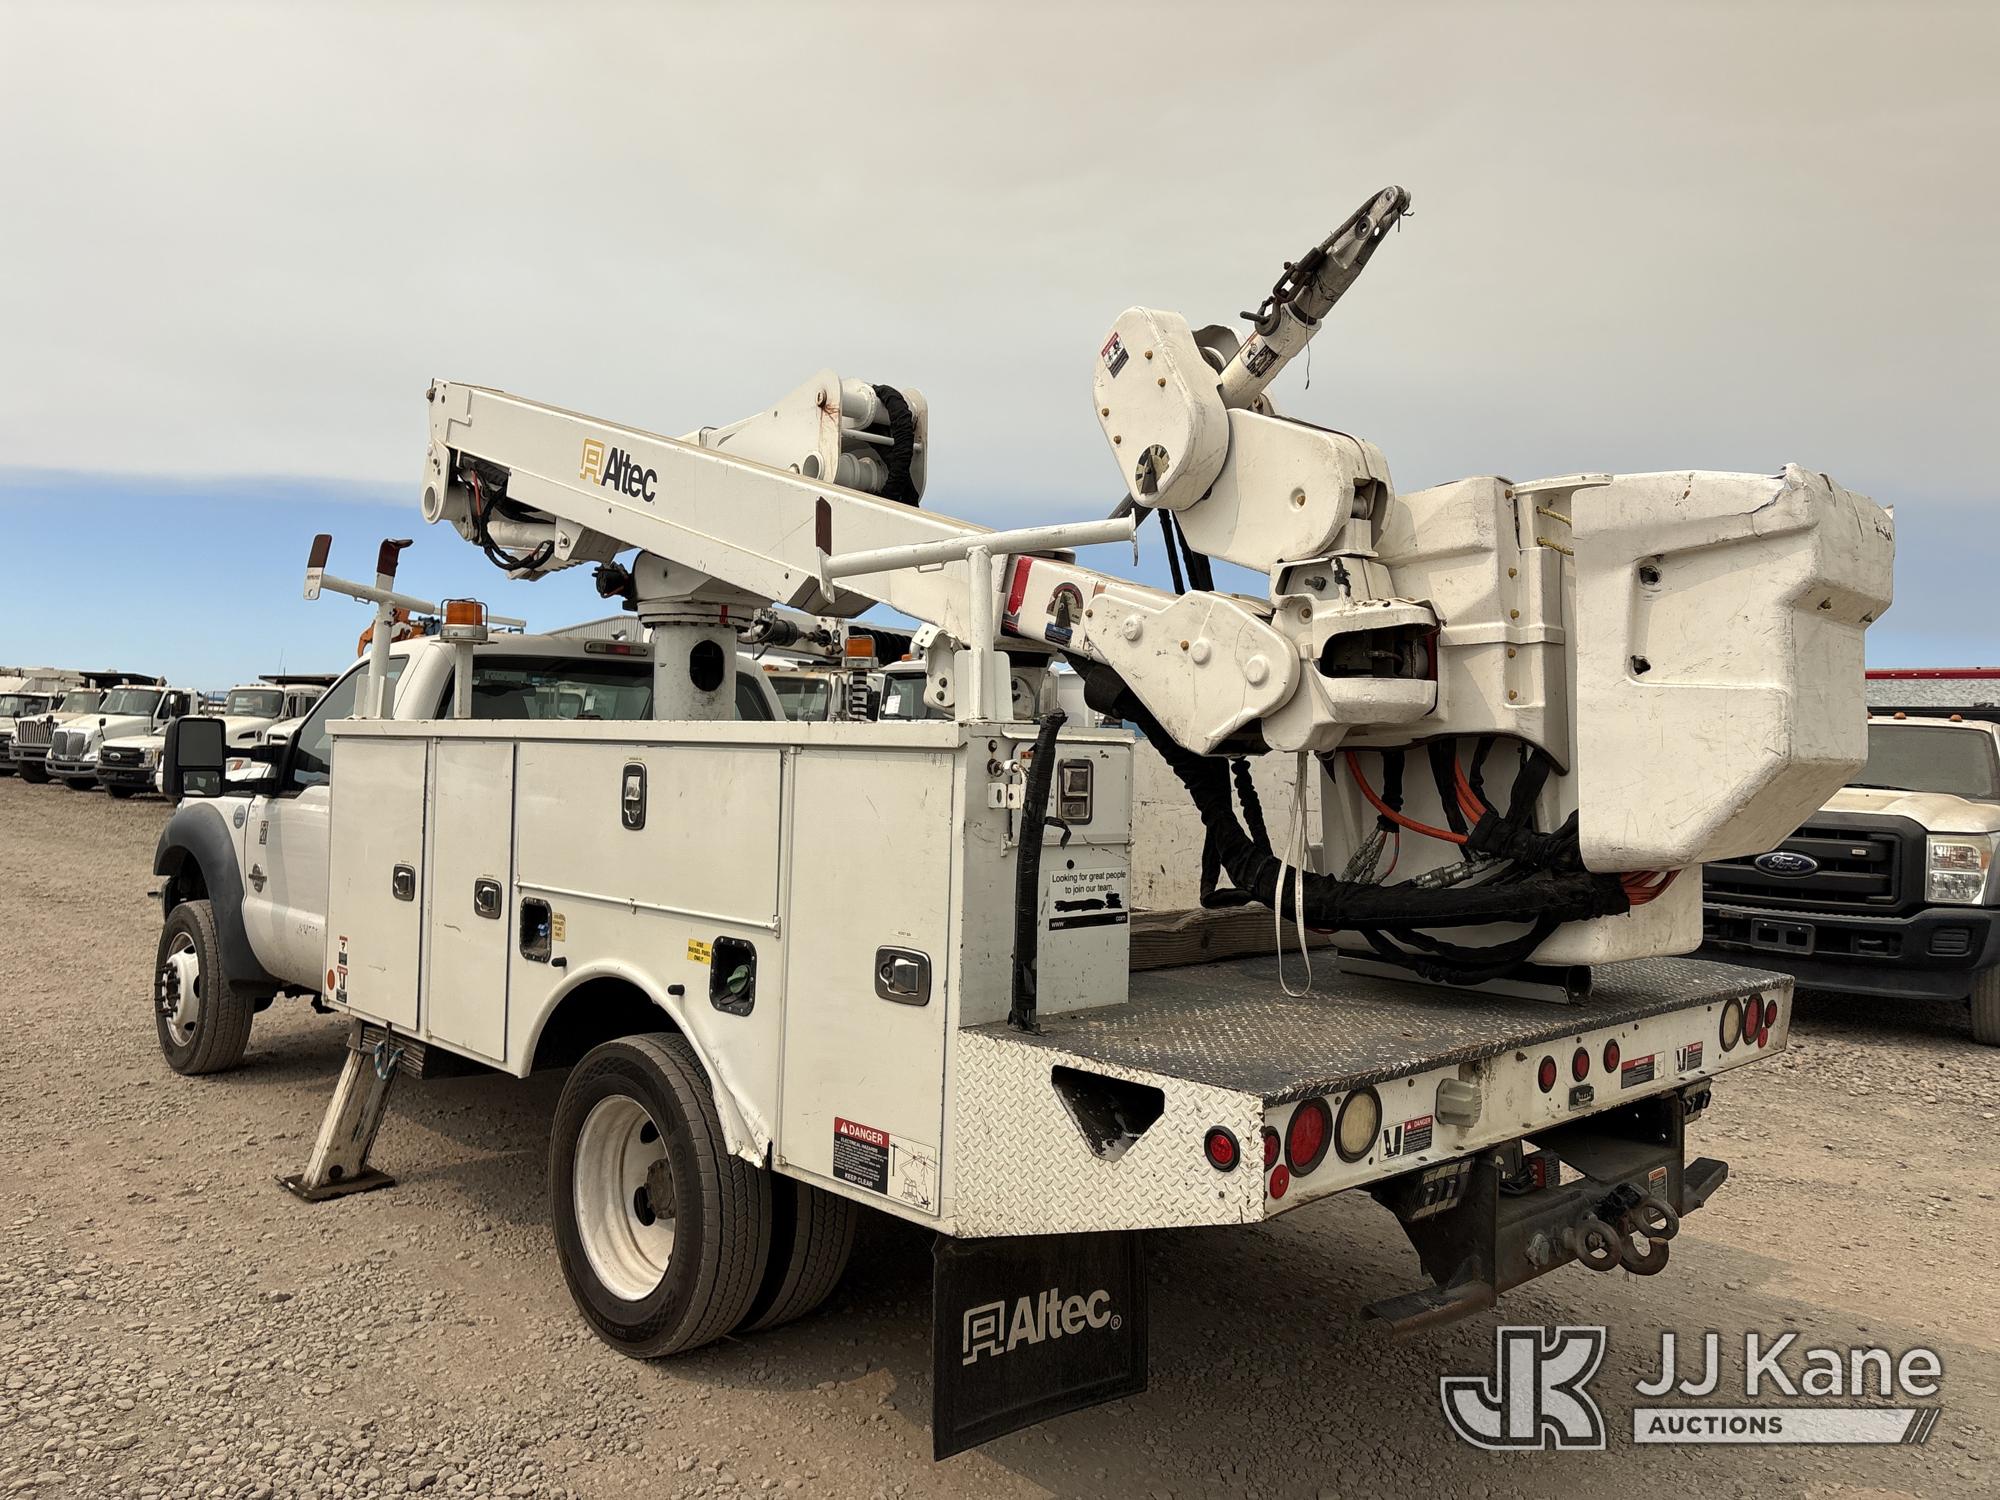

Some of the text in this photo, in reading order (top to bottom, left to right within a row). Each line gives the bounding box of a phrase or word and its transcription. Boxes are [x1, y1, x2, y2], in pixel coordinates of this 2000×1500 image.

[600, 446, 658, 503] Altec
[1767, 855, 1802, 870] Ford
[1052, 870, 1127, 883] Looking for great people
[1065, 886, 1072, 894] to
[1072, 884, 1085, 896] join
[1097, 883, 1114, 892] team.
[848, 1124, 883, 1145] DANGER
[844, 1172, 873, 1188] KEEP CLEAR
[1006, 1287, 1112, 1352] Altec
